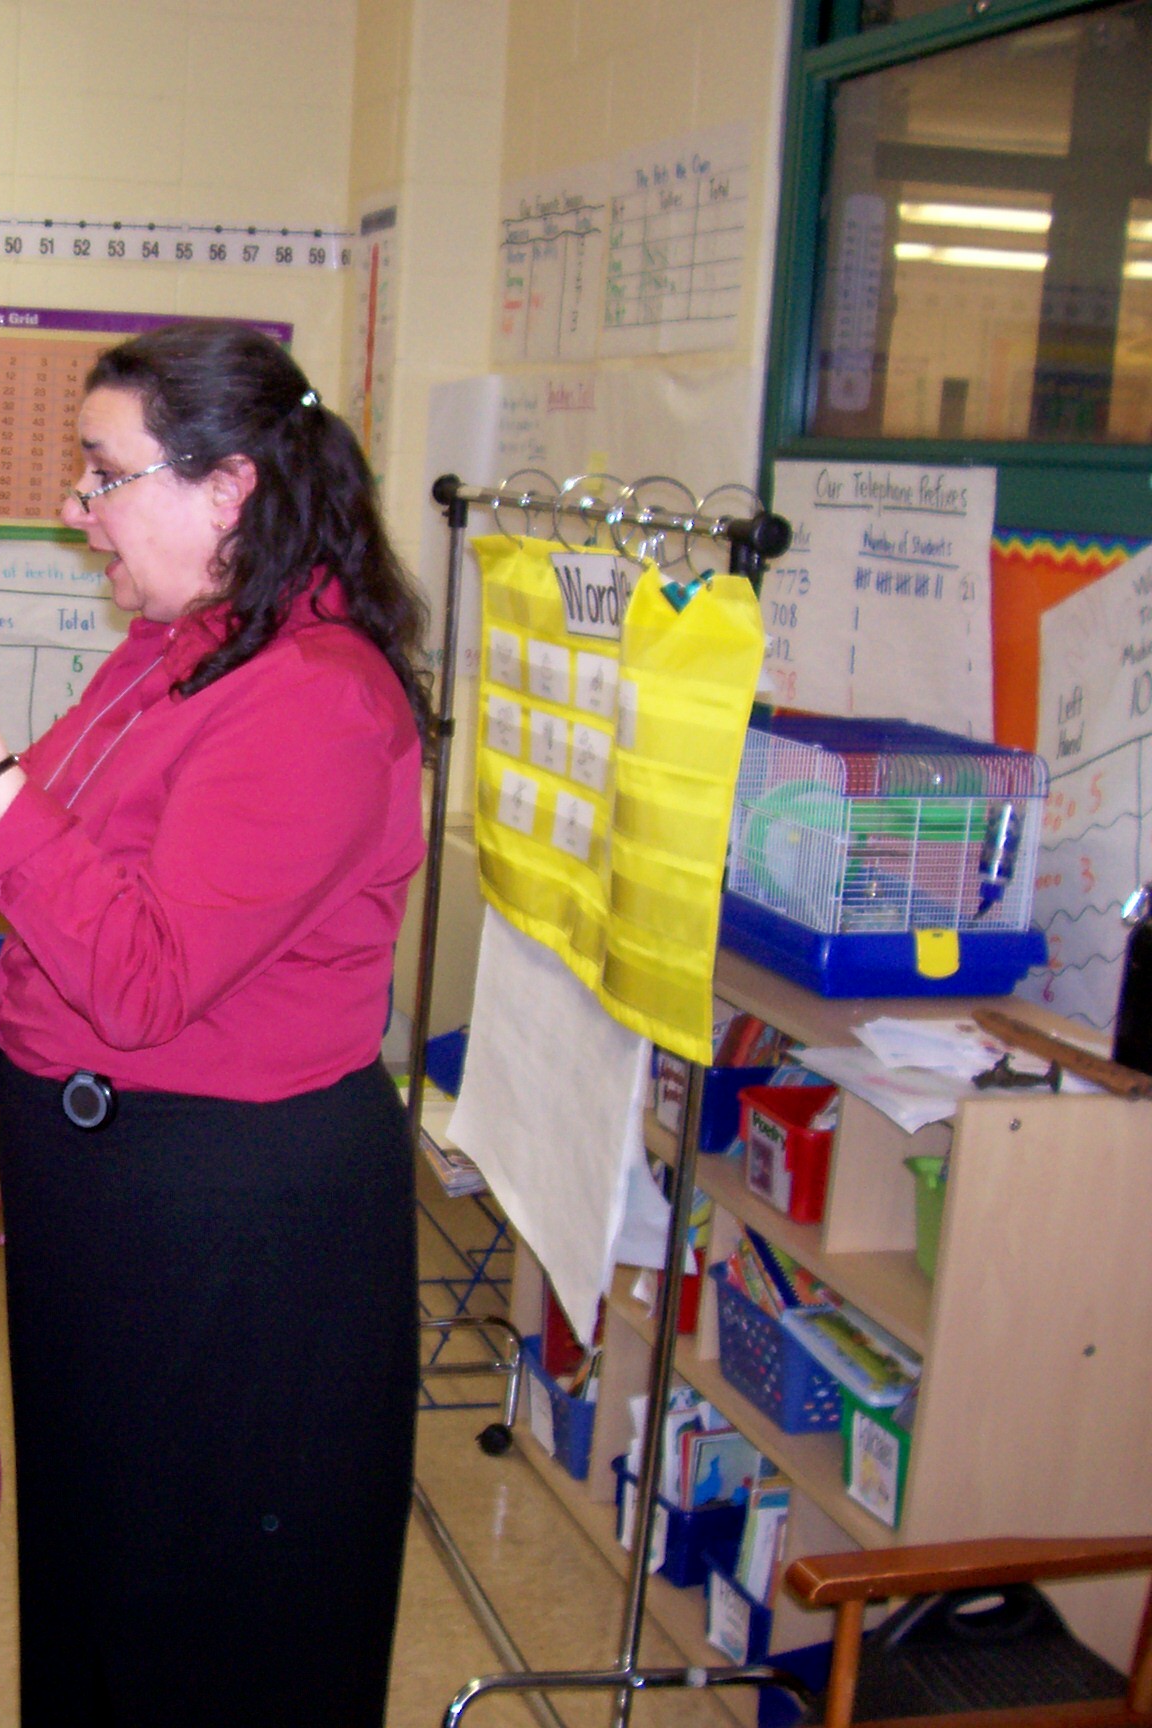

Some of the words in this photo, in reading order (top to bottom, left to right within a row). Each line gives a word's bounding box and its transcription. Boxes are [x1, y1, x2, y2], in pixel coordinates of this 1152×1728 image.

[4, 236, 23, 254] 50
[39, 237, 55, 255] 51
[73, 239, 91, 256] 52
[107, 239, 125, 257] 53
[141, 240, 160, 259] 54
[175, 242, 193, 260] 55
[209, 243, 227, 261] 56
[242, 245, 260, 263] 57
[275, 246, 293, 264] 58
[308, 247, 326, 265] 59
[8, 312, 39, 325] Grid
[815, 468, 844, 500] Our
[853, 471, 913, 518] Telephone
[554, 564, 619, 627] Word
[776, 569, 812, 596] 773
[57, 607, 96, 631] Total
[771, 602, 798, 629] 708
[66, 682, 74, 697] 3
[1090, 772, 1103, 814] 5
